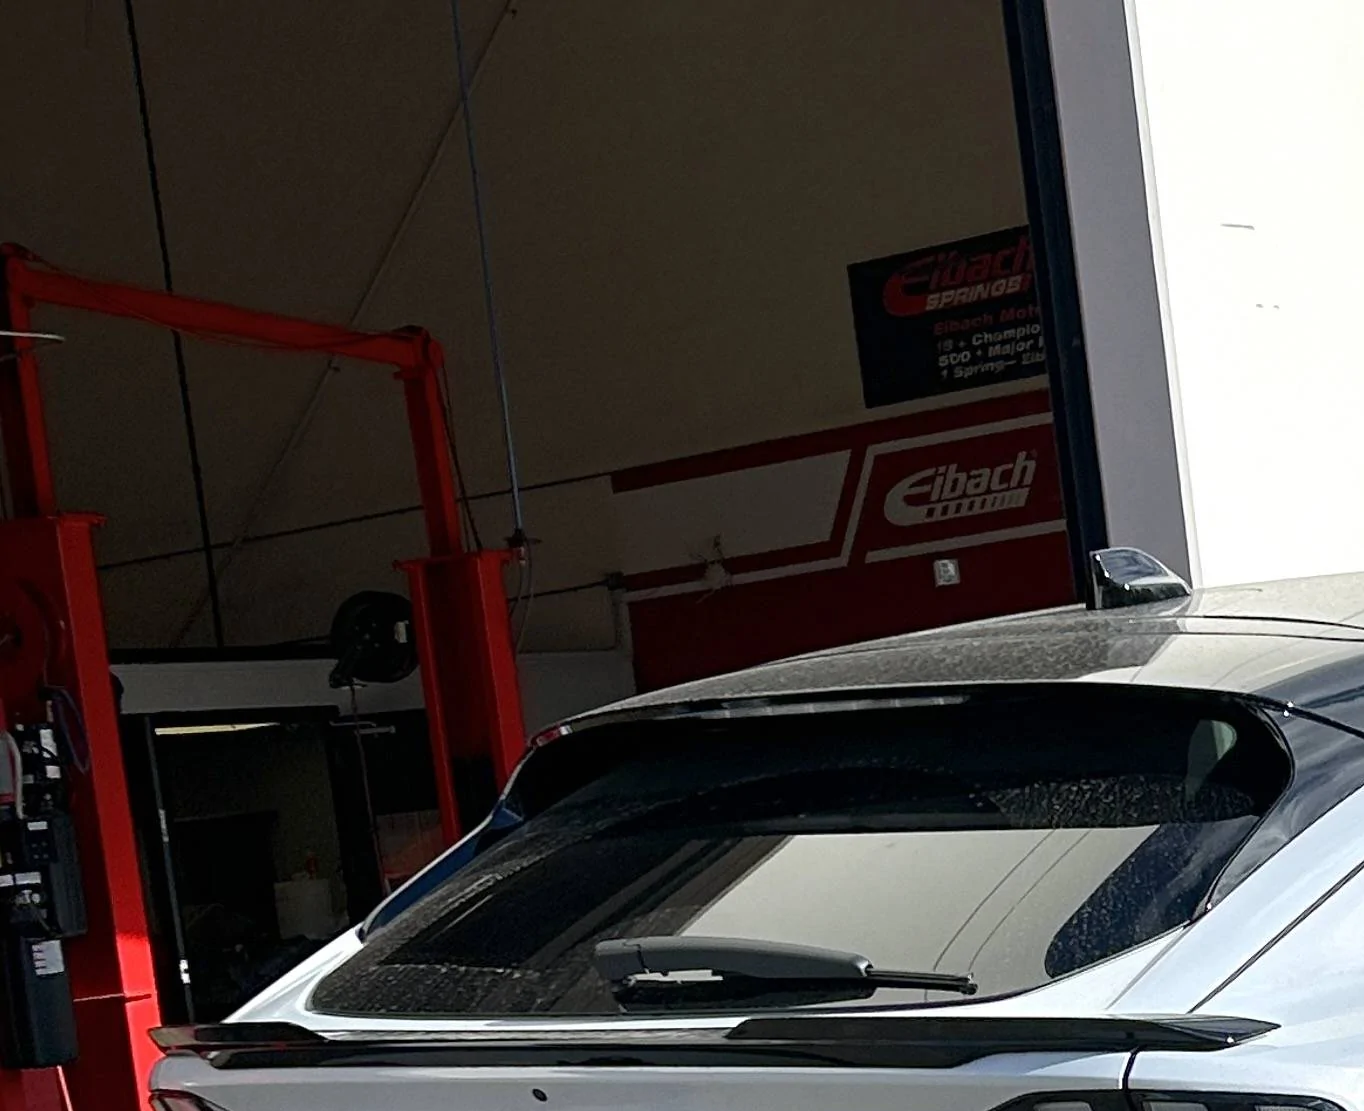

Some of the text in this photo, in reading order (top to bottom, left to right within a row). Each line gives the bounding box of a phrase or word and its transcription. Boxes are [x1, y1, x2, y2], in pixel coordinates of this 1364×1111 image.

[933, 313, 993, 336] Eibach
[971, 324, 1040, 346] Champio
[938, 351, 972, 367] 500
[988, 338, 1035, 358] Major
[884, 450, 1037, 527] Eibach
